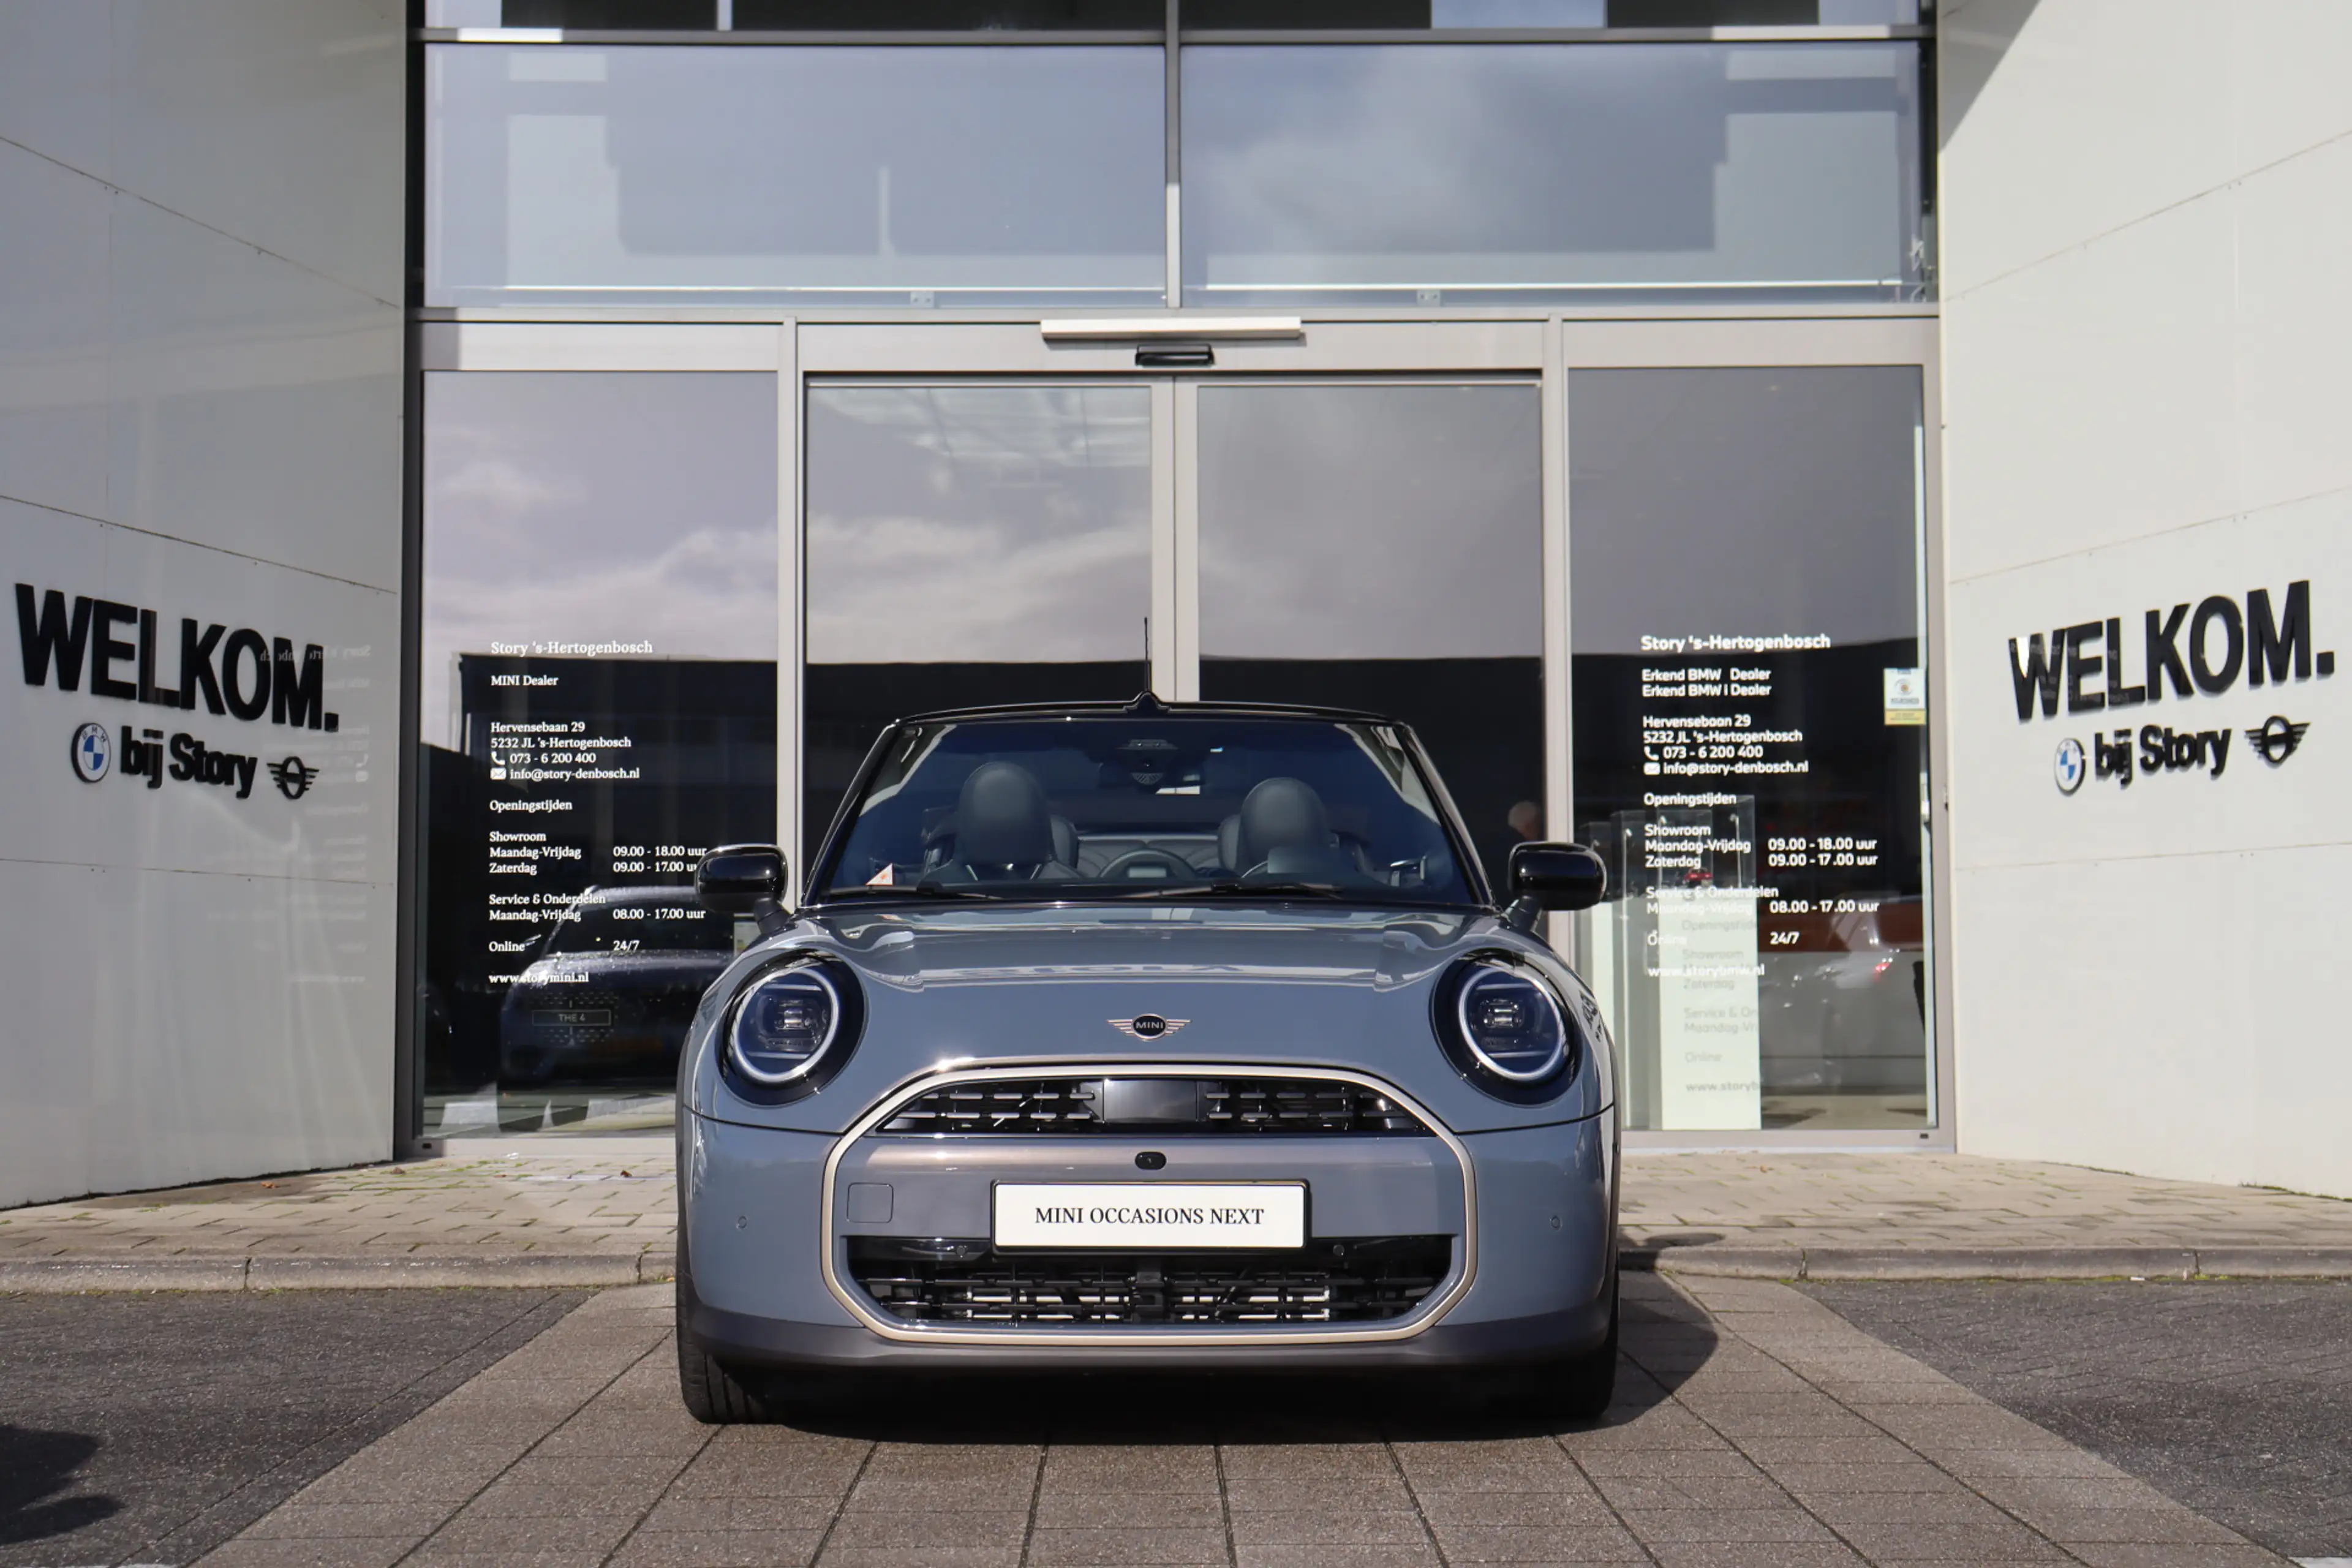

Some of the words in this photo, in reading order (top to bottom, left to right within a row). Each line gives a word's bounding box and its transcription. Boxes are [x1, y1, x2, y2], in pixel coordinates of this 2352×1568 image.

[491, 642, 528, 657] Story
[1641, 635, 1686, 652] Story
[15, 582, 339, 732] WELKOM.
[2008, 579, 2334, 723] WELKOM.
[491, 676, 520, 685] MINI
[523, 675, 558, 685] Dealer
[1642, 669, 1685, 681] Erkend
[1688, 669, 1721, 681] BMW
[1730, 668, 1771, 680] Dealer
[1642, 684, 1685, 697] Erkend
[1688, 684, 1721, 696] BMW
[1724, 684, 1728, 696] i
[1731, 684, 1771, 696] Dealer
[491, 723, 568, 732] Hervensebaan
[571, 722, 585, 732] 29
[1643, 715, 1732, 728] Hervensebaan
[1734, 715, 1751, 727] 29
[491, 738, 518, 748] 5232
[521, 737, 535, 748] JL
[1643, 731, 1674, 744] 5232
[1677, 731, 1691, 744] JL
[510, 753, 531, 763] 073
[541, 753, 548, 763] 6
[552, 753, 572, 763] 200
[575, 753, 597, 763] 400
[1663, 747, 1687, 759] 073
[1698, 746, 1707, 759] 6
[1709, 746, 1735, 759] 200
[1738, 745, 1763, 758] 400
[2095, 729, 2132, 787] bij
[2139, 724, 2231, 778] Story
[121, 726, 164, 789] bij
[169, 733, 257, 799] Story
[1663, 761, 1809, 776] info@story-denbosch.nl
[510, 767, 639, 782] info@story-denbosch.nl
[489, 799, 573, 813] Openingstijden
[1643, 793, 1736, 807] Openingstijden
[489, 832, 546, 842] Showroom
[1644, 825, 1711, 837] Showroom
[1645, 839, 1751, 854] Maandag-Vrijdag
[1768, 838, 1806, 851] 09.00
[1817, 838, 1853, 851] 18.00
[1856, 840, 1877, 850] uur
[489, 846, 582, 860] Maandag-Vrijdag
[613, 846, 644, 857] 09.00
[655, 846, 685, 856] 18.00
[687, 848, 707, 856] uur
[1645, 855, 1702, 869] Zaterdag
[1768, 854, 1806, 867] 09.00
[1857, 855, 1879, 865] uur
[489, 862, 537, 876] Zaterdag
[613, 862, 644, 872] 09.00
[655, 861, 685, 872] 17.00
[1707, 885, 1779, 898] Onderdelen
[489, 894, 529, 905] Service
[532, 894, 540, 904] &
[543, 894, 606, 904] Onderdelen
[1770, 900, 1808, 913] 08.00
[1859, 902, 1879, 912] uur
[489, 910, 581, 923] Maandag-Vrijdag
[613, 909, 644, 919] 08.00
[655, 908, 684, 919] 17.00
[1770, 932, 1800, 944] 24/7
[489, 941, 525, 952] Online
[613, 940, 640, 951] 24/7
[559, 1014, 578, 1022] THE
[1136, 1021, 1163, 1030] MINI
[1035, 1207, 1083, 1224] MINI
[1090, 1208, 1204, 1224] OCCASIONS
[1210, 1208, 1264, 1224] NEXT
